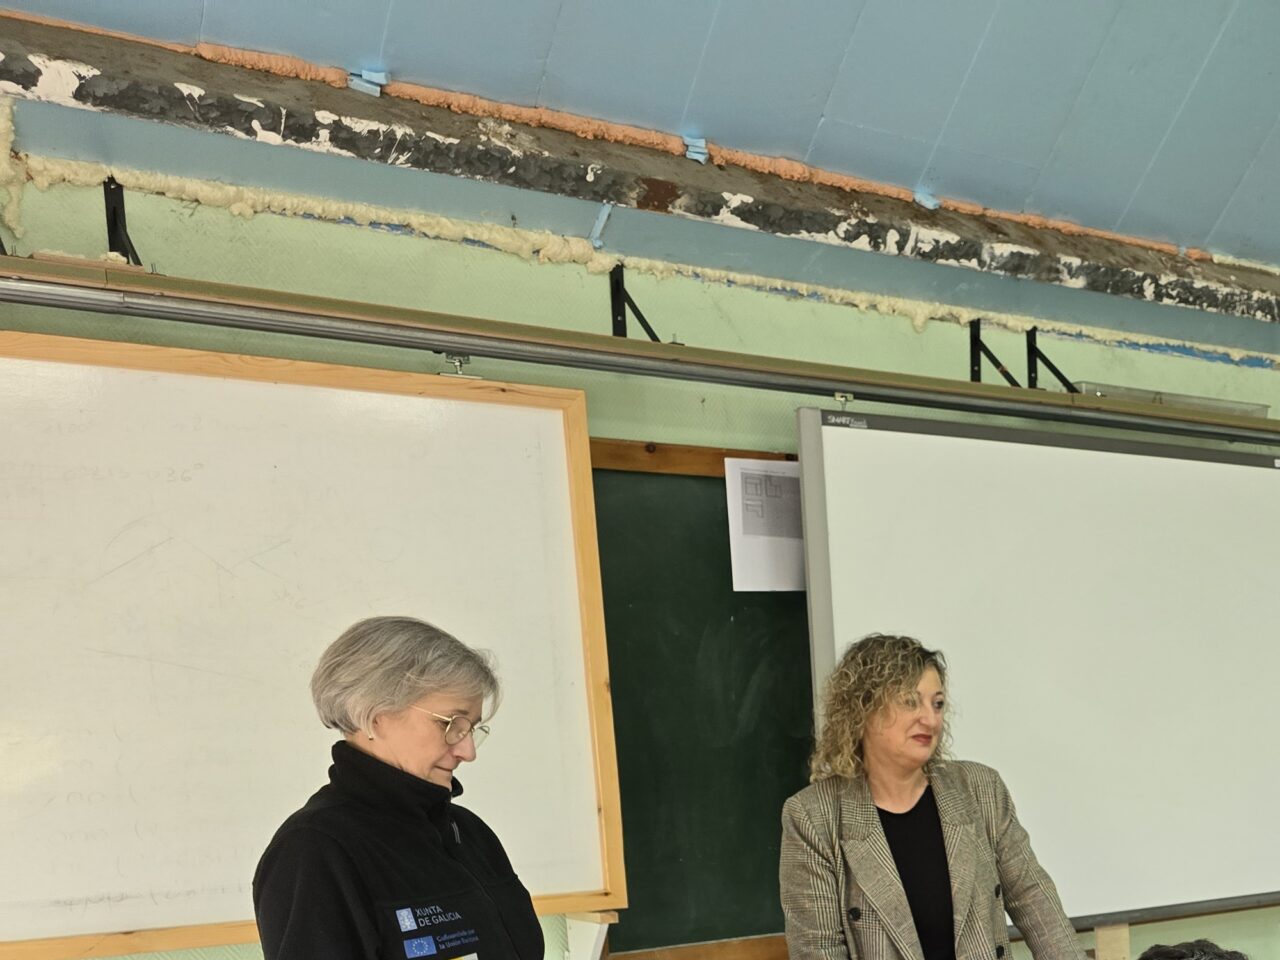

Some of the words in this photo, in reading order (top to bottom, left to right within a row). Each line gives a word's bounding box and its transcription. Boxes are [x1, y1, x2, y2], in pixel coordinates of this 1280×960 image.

[415, 905, 443, 917] XUNTA
[418, 918, 432, 927] DE
[431, 912, 462, 924] GALICIA
